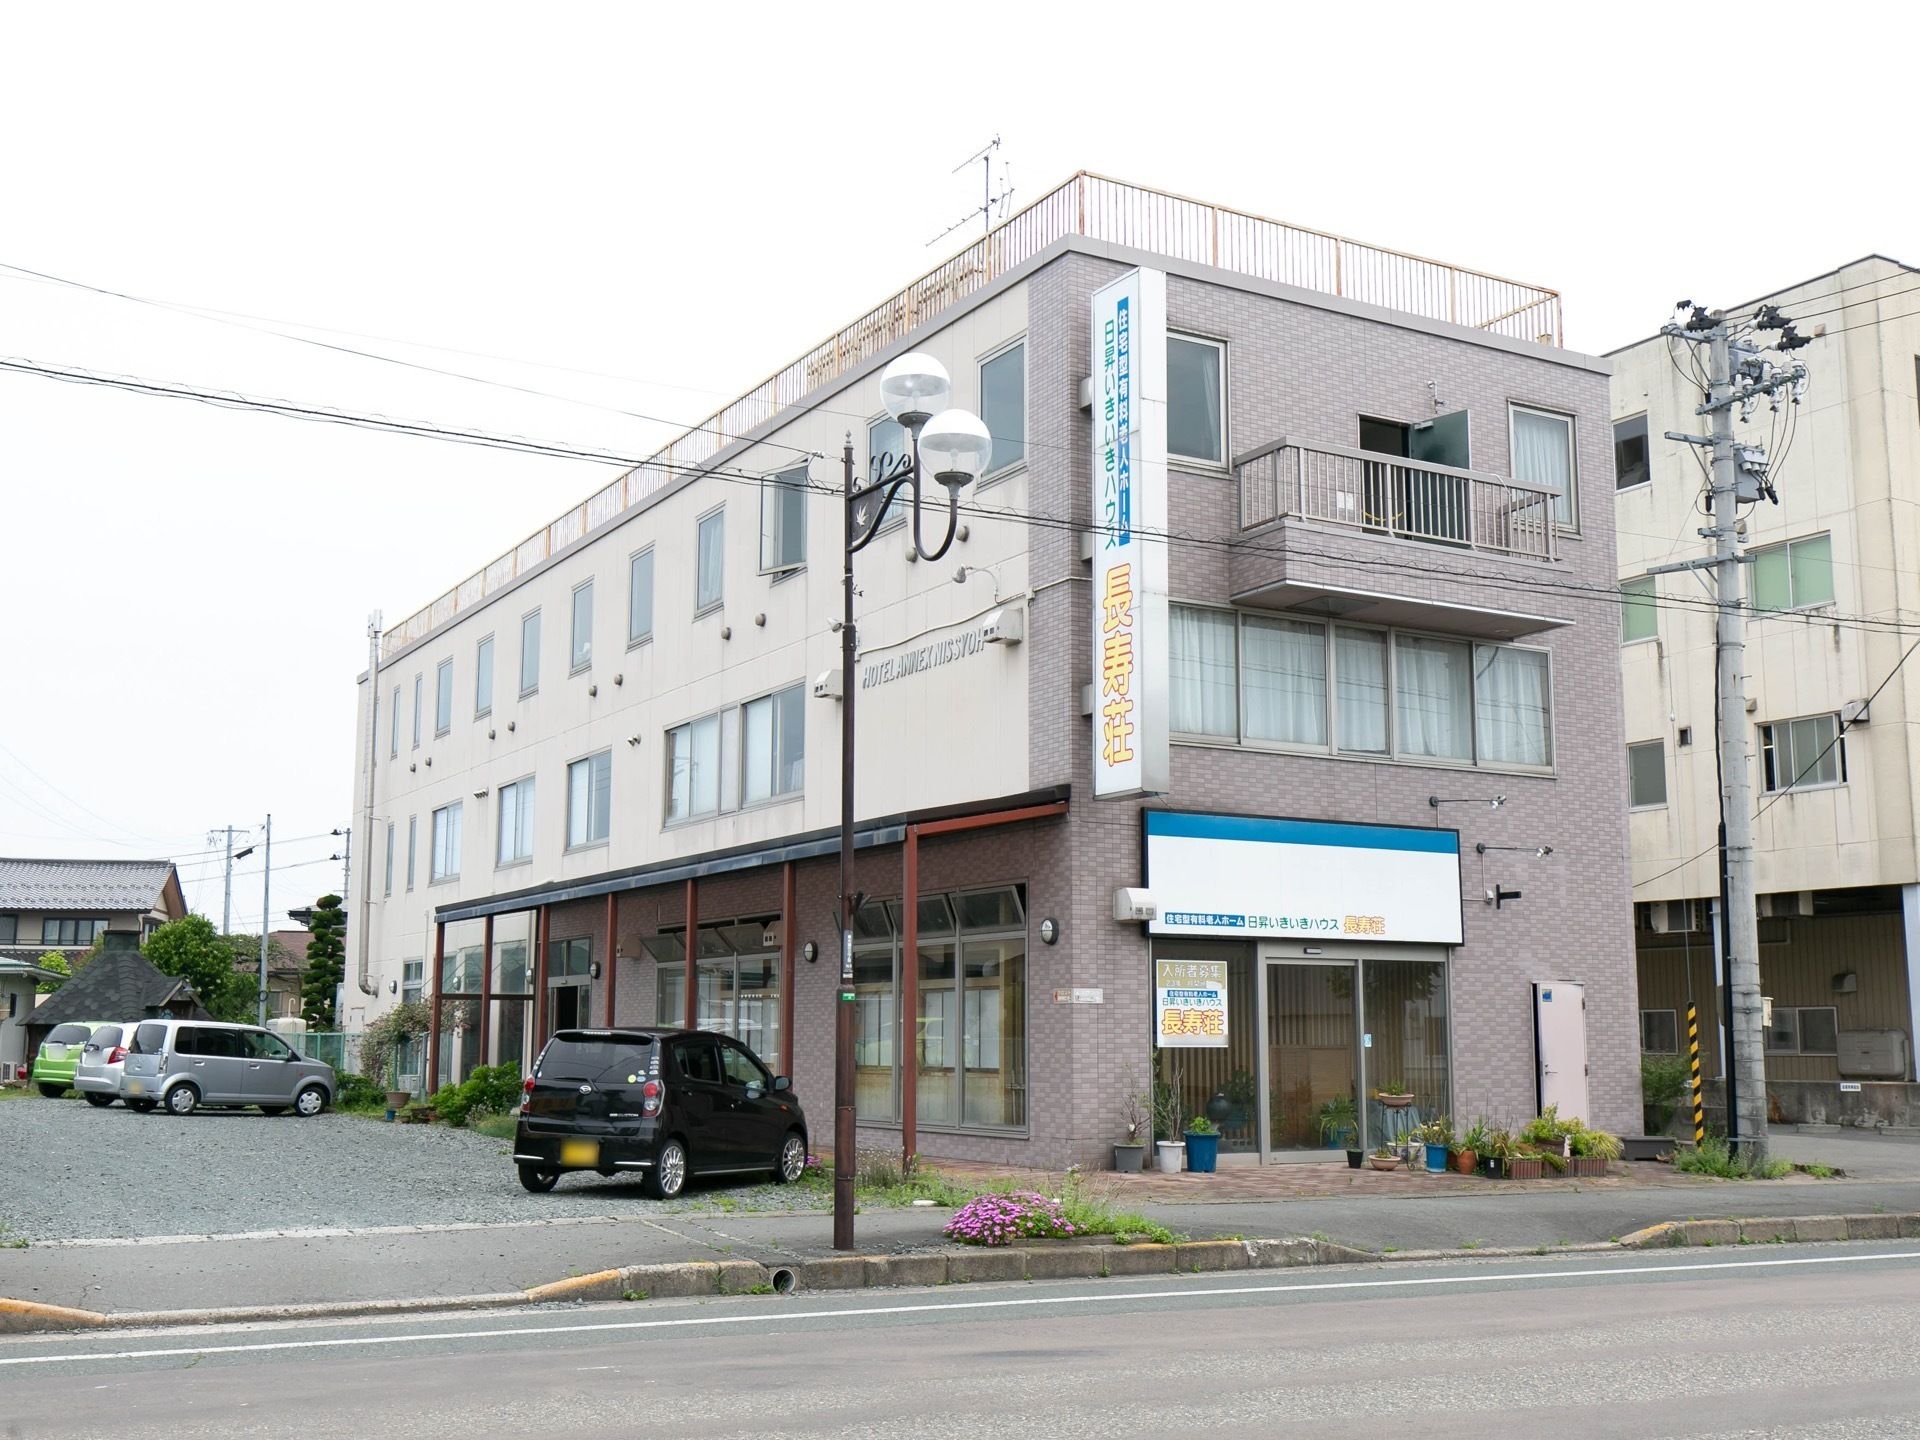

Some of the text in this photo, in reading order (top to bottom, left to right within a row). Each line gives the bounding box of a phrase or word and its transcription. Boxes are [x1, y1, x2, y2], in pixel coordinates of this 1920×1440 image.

[1104, 319, 1117, 551] 日昇いきいきハウス
[863, 657, 896, 689] HOTEL
[896, 645, 933, 678] ANNEX
[1103, 562, 1134, 767] 長寿荘
[1166, 914, 1385, 934] 住宅型有料老人ホーム 日昇いきいきハウス 長寿荘
[1162, 964, 1222, 978] 入所者募集
[1162, 998, 1222, 1006] 日昇いきいきハウス
[1162, 1008, 1224, 1035] 長寿荘
